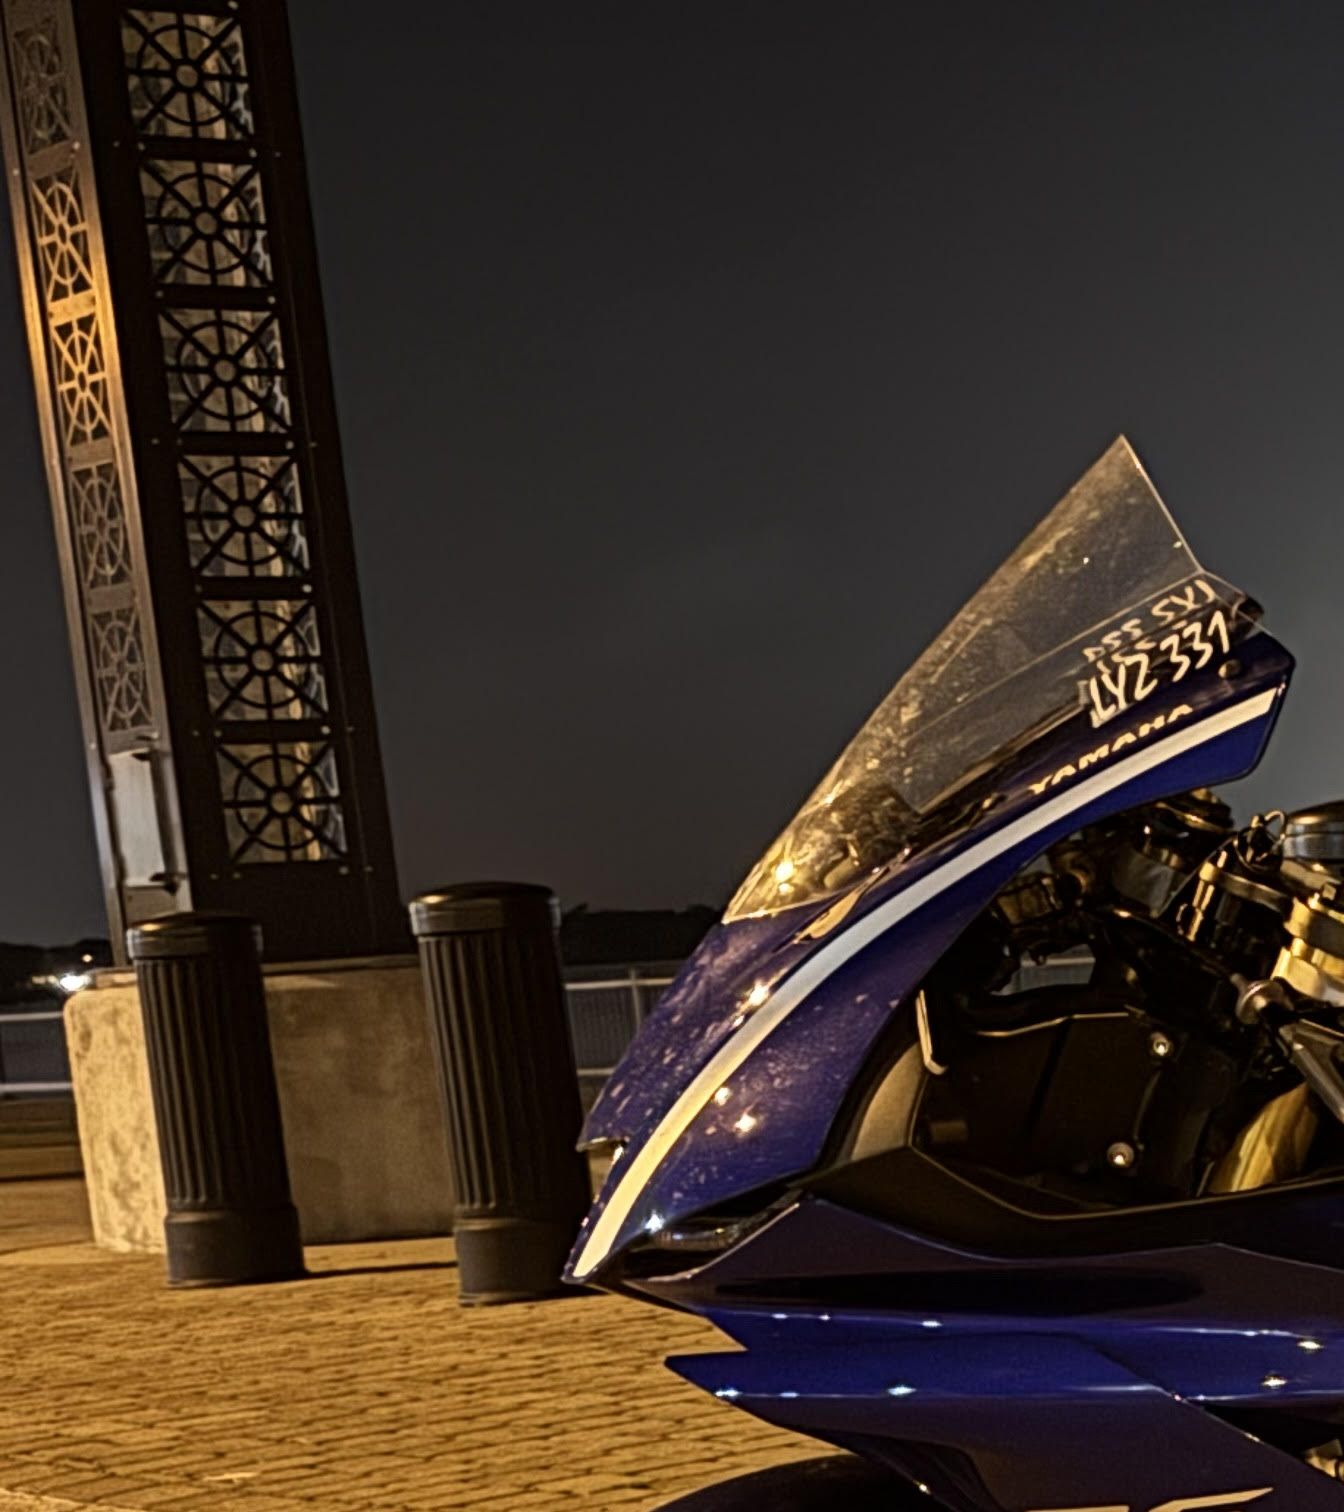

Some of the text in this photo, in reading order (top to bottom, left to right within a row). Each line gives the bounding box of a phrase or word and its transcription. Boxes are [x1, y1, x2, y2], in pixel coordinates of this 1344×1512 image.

[1089, 610, 1230, 722] LYZ 331
[1028, 703, 1194, 795] YAMAHA
